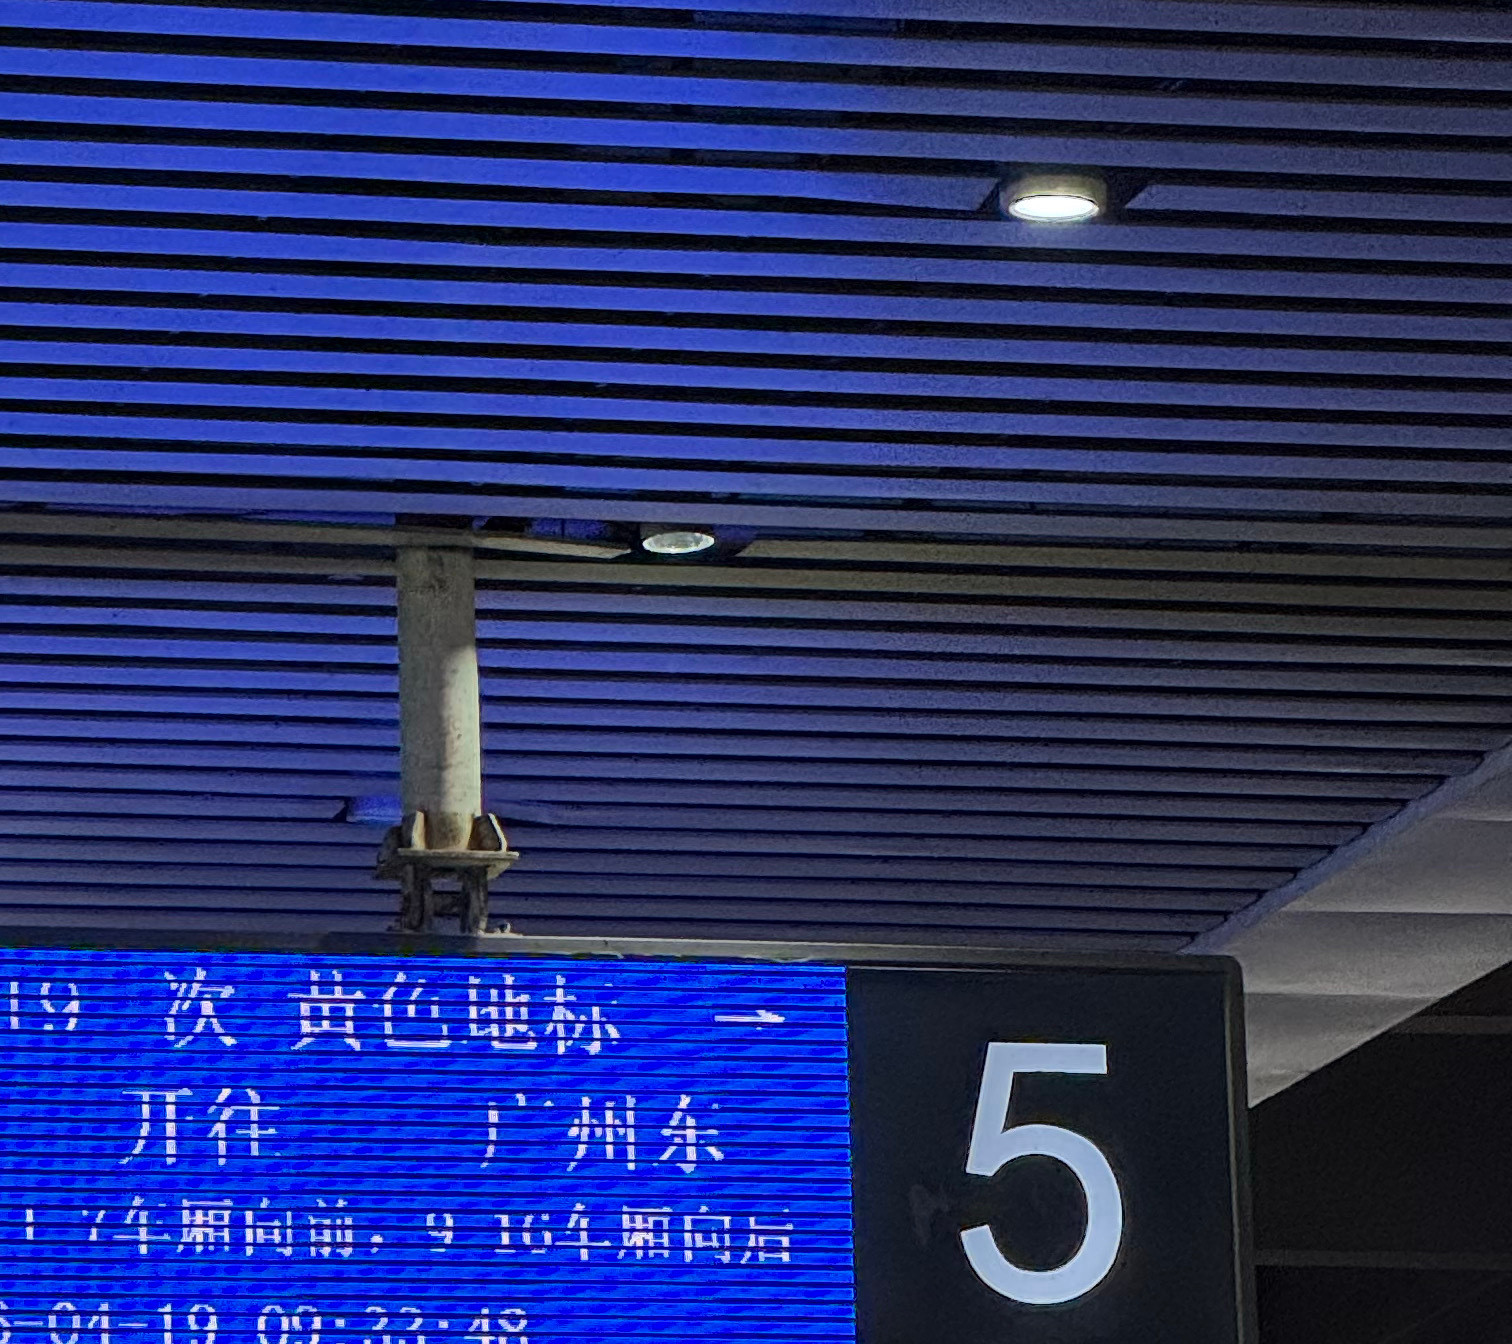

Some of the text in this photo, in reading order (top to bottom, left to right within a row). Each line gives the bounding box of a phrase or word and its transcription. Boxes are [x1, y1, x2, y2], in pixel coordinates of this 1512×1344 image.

[164, 968, 238, 1048] 次
[288, 969, 622, 1056] 黄色地标
[118, 1086, 283, 1166] 开往
[479, 1092, 726, 1174] 广州东
[960, 1042, 1124, 1306] 5
